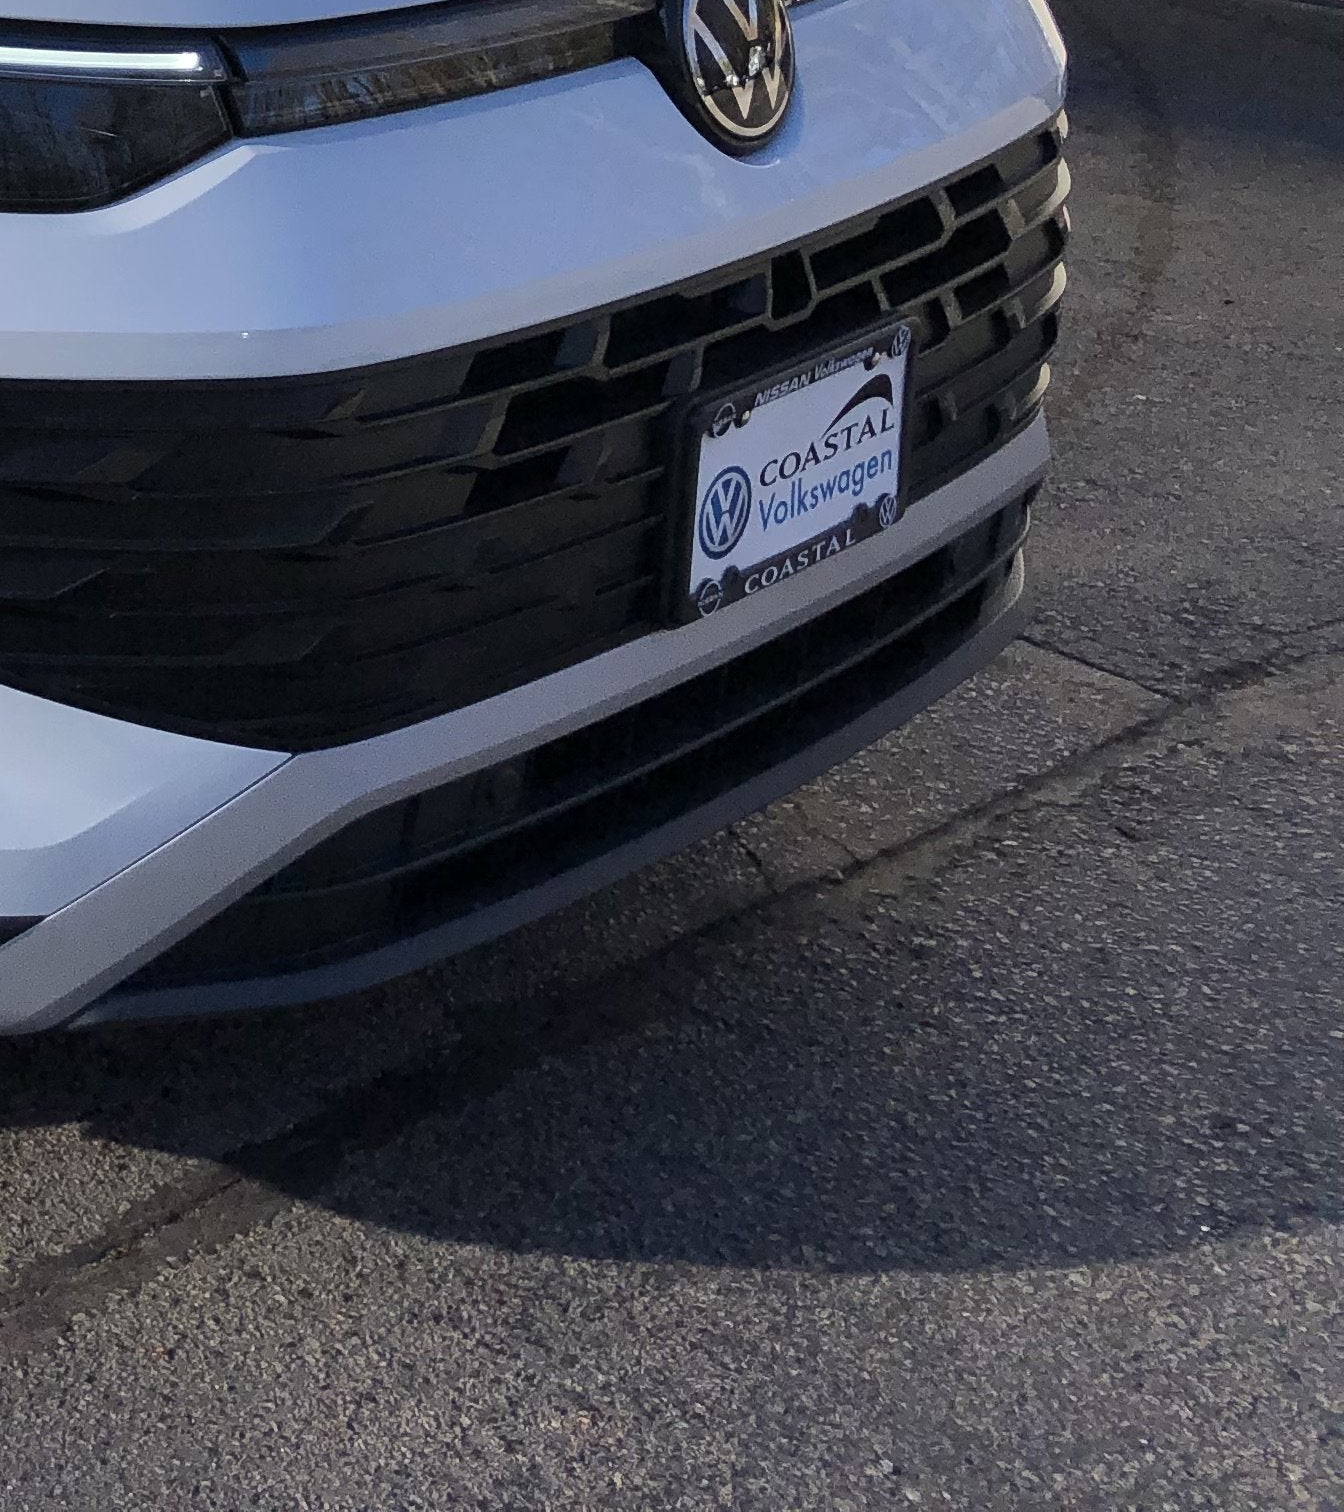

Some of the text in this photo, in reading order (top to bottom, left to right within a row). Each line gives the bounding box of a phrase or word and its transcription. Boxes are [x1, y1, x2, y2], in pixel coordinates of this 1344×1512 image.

[754, 373, 812, 408] NISSAN
[759, 408, 895, 486] COASTAL
[758, 448, 893, 532] Volkswagen
[744, 528, 856, 595] COASTAL
